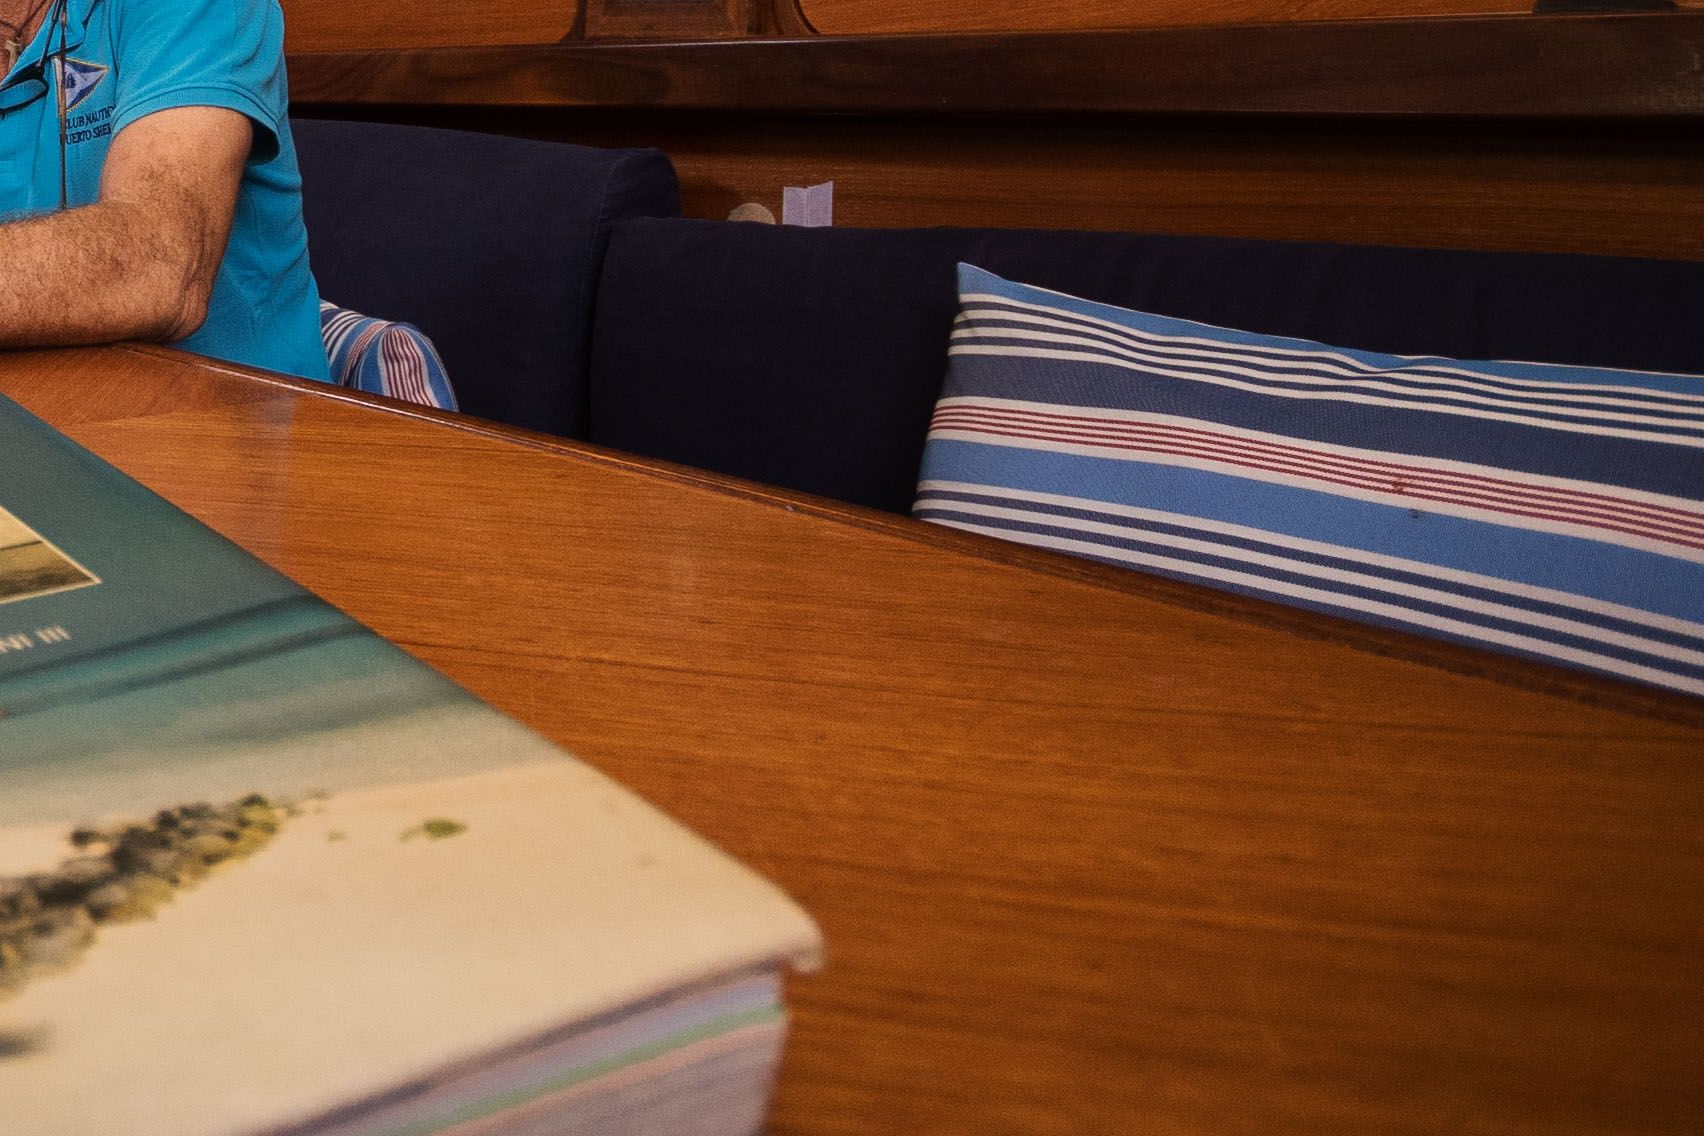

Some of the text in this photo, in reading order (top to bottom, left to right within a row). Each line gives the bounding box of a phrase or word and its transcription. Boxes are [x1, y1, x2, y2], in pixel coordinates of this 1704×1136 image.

[66, 116, 85, 129] LUB
[65, 129, 92, 145] UERTO
[35, 624, 72, 645] III
